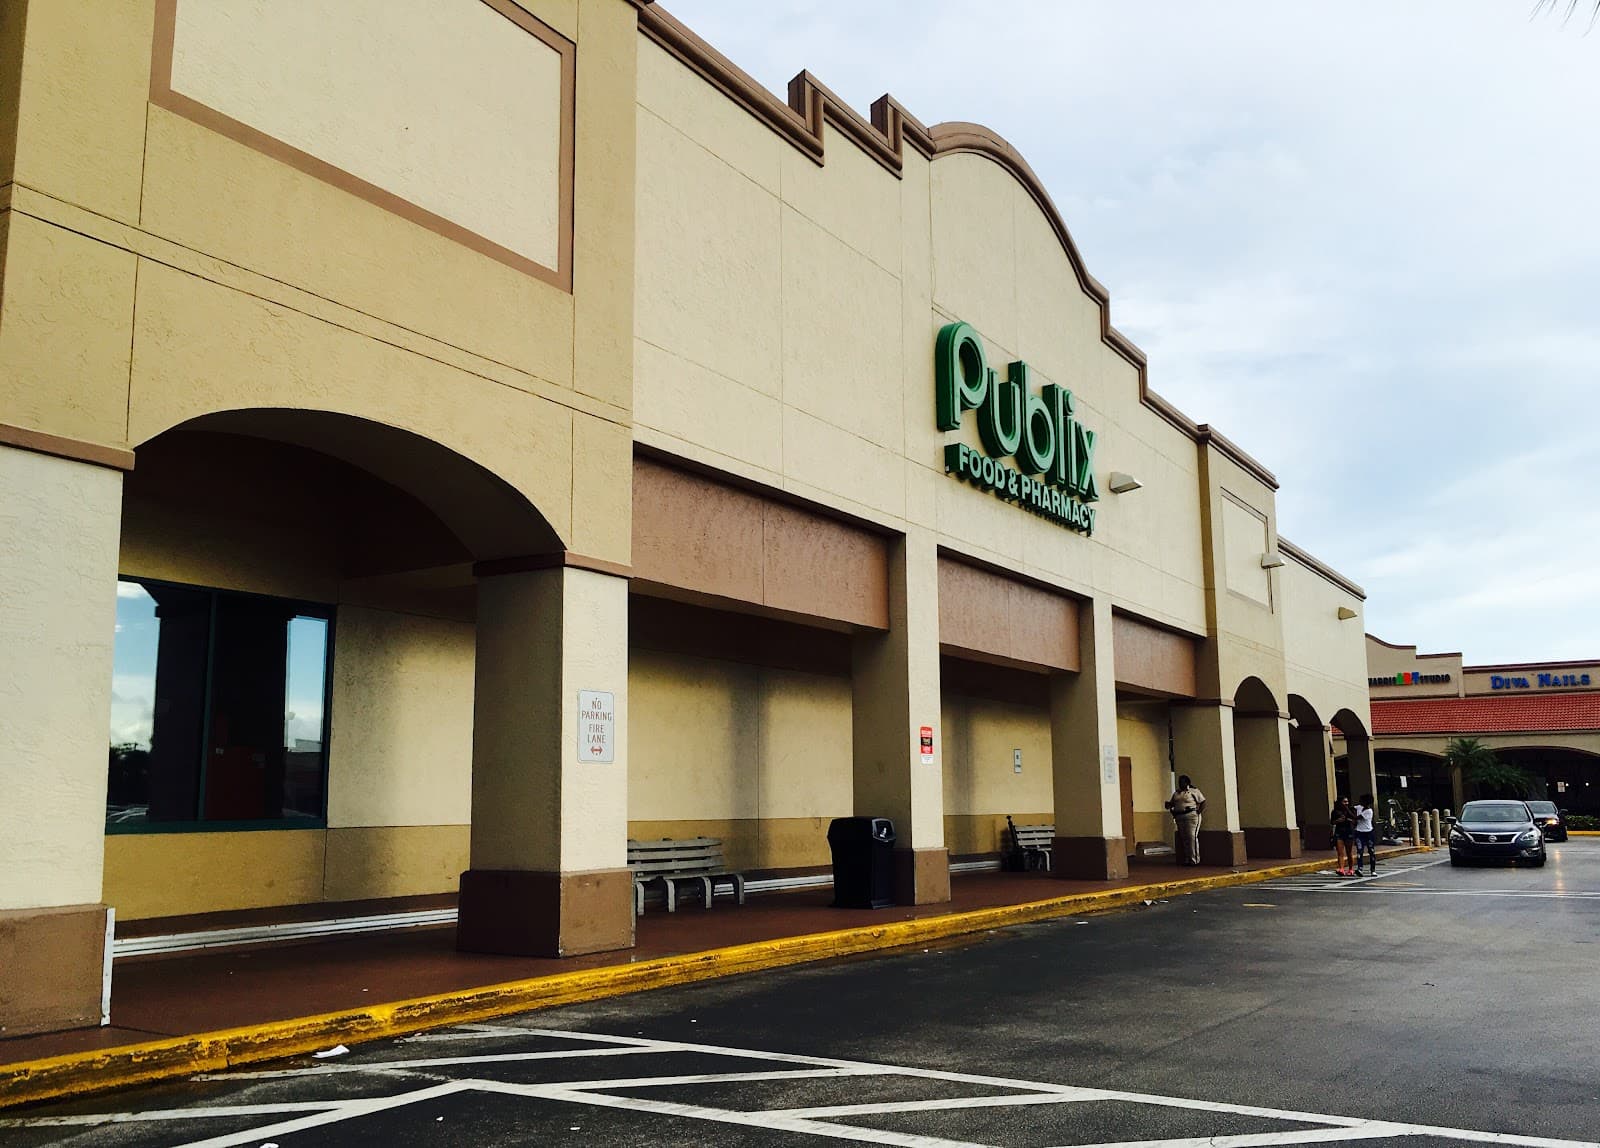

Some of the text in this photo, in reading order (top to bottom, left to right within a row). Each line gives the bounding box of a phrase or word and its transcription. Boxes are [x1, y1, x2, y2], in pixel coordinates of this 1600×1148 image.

[935, 321, 1099, 501] Publix
[955, 444, 1096, 533] FOOD & PHARMACY
[591, 700, 602, 709] NO
[581, 711, 612, 721] PARKING
[588, 723, 605, 733] FIRE
[587, 734, 606, 744] LANE
